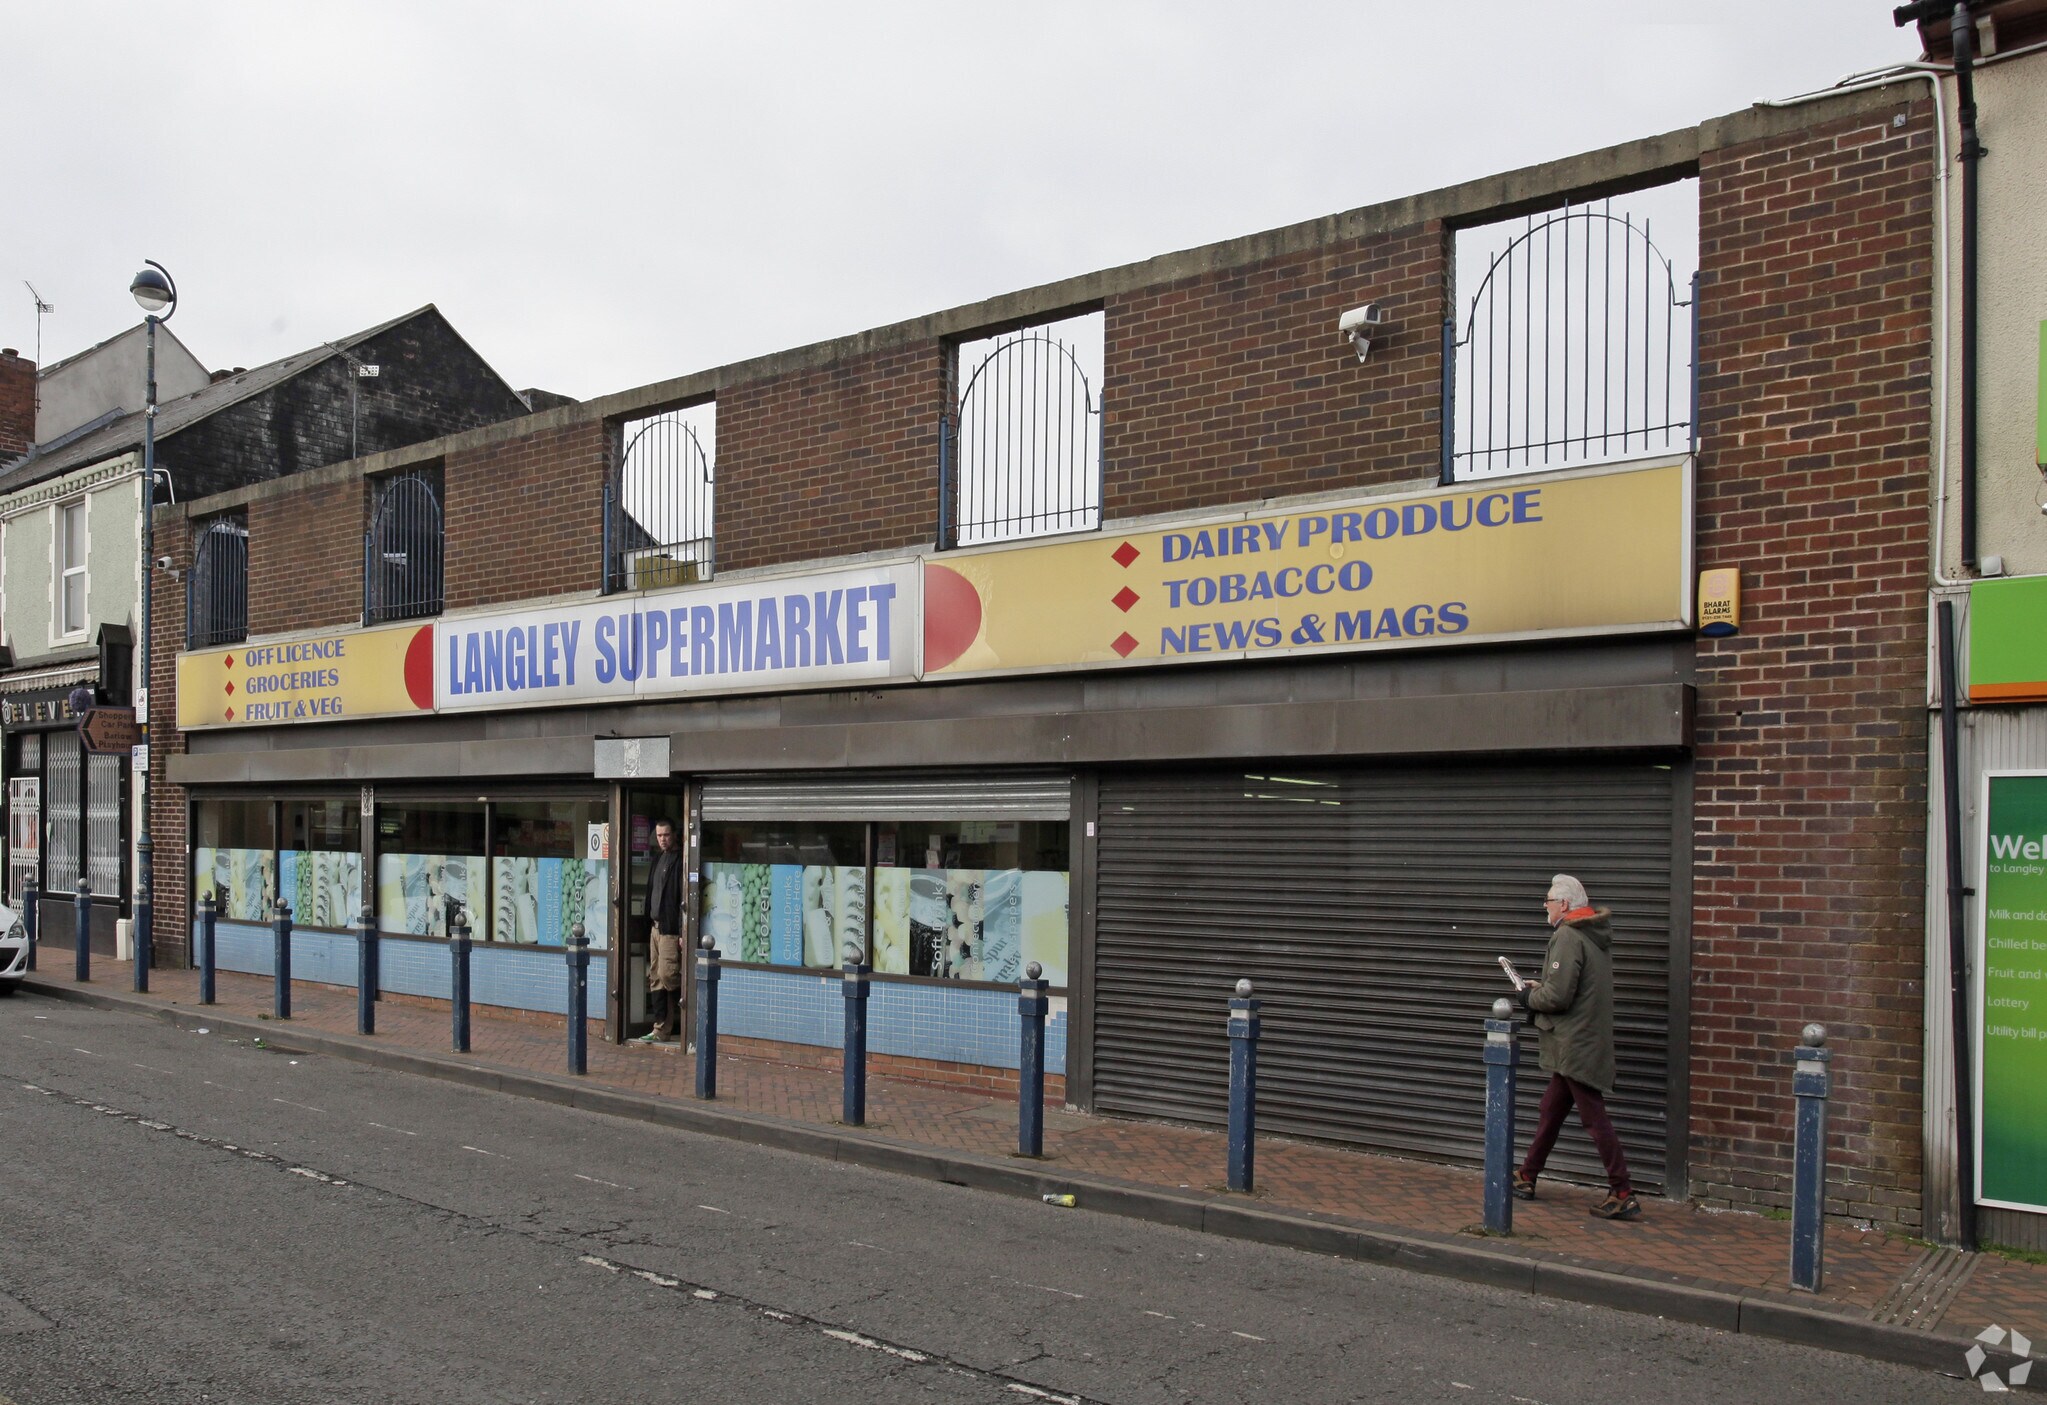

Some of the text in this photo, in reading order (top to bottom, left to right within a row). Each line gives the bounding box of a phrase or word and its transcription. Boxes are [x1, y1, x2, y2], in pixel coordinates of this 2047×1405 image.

[1162, 489, 1543, 563] DAIRY PRODUCE
[1162, 560, 1373, 608] TOBACCO
[1703, 600, 1731, 608] BHARAT
[1703, 607, 1731, 615] ALARMS
[449, 582, 896, 695] LANGLEY SUPERMARKET
[1160, 602, 1469, 655] NEWS & MAGS
[245, 639, 345, 667] OFF LICENCE
[245, 668, 339, 694] GROCERIES
[245, 697, 343, 720] FRUIT & VEG
[101, 721, 136, 730] Car Park
[98, 741, 133, 750] Playhou
[1989, 863, 2044, 876] to Langley
[574, 879, 582, 923] ozen
[552, 891, 560, 942] Available
[727, 877, 742, 955] Grocery
[757, 885, 771, 957] Frozen
[783, 875, 792, 961] Chilled Drinks
[792, 870, 801, 961] Available Here
[1989, 909, 2011, 920] Milk
[2012, 910, 2034, 921] and
[931, 937, 943, 970] Soft
[1988, 938, 2028, 950] Chilled
[1987, 967, 2041, 980] Fruit and
[1987, 996, 2029, 1011] Lottery
[1986, 1025, 2019, 1040] Utility
[2021, 1027, 2036, 1038] bill
